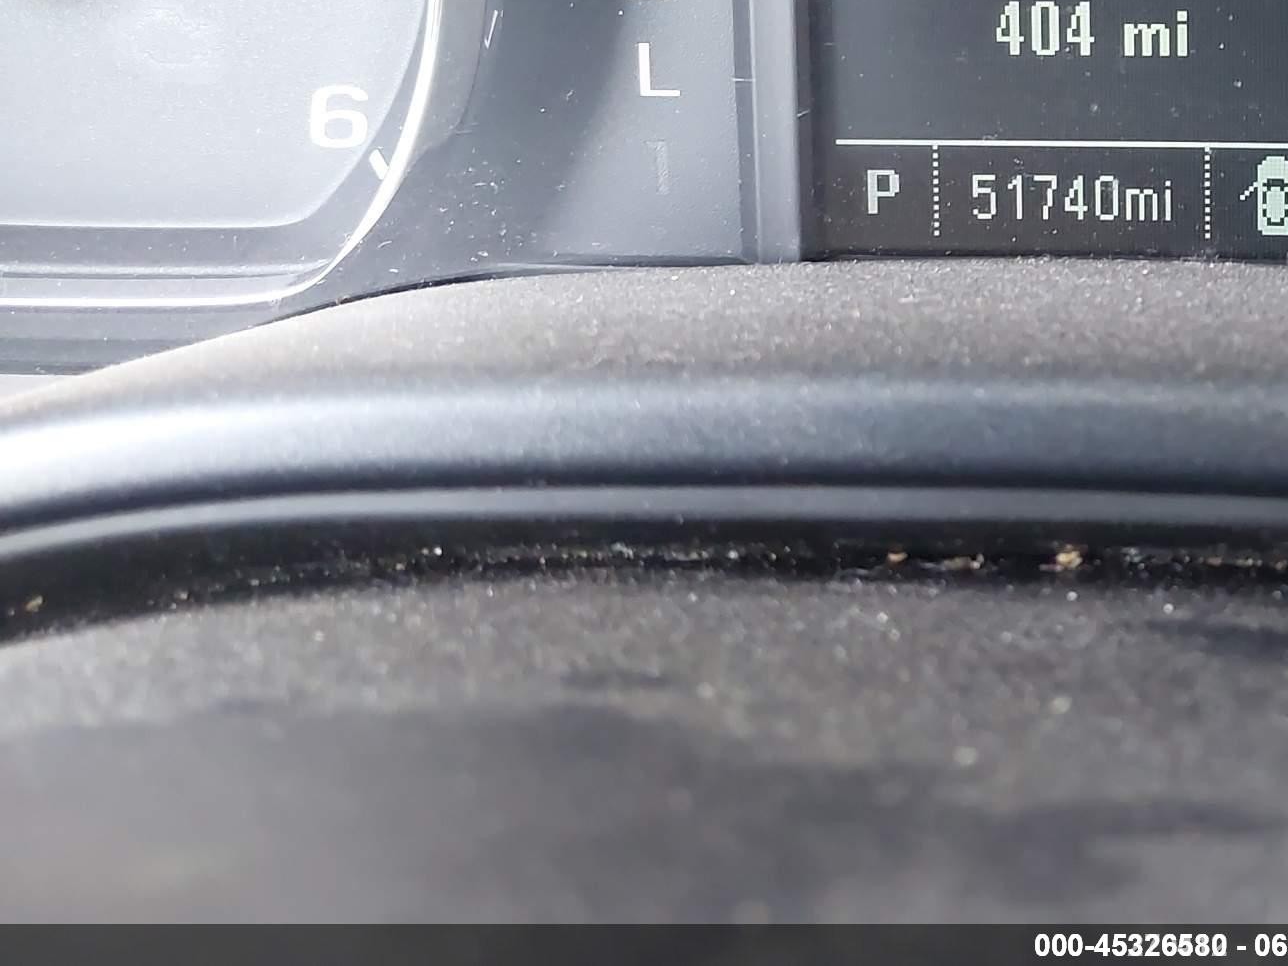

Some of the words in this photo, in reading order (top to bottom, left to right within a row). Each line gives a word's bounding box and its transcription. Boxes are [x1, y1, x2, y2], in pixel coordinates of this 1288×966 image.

[997, 1, 1094, 55] 404
[1124, 11, 1187, 56] mi
[639, 43, 680, 96] L
[308, 84, 368, 148] 6
[867, 170, 899, 214] P
[973, 175, 1171, 220] 51740mi
